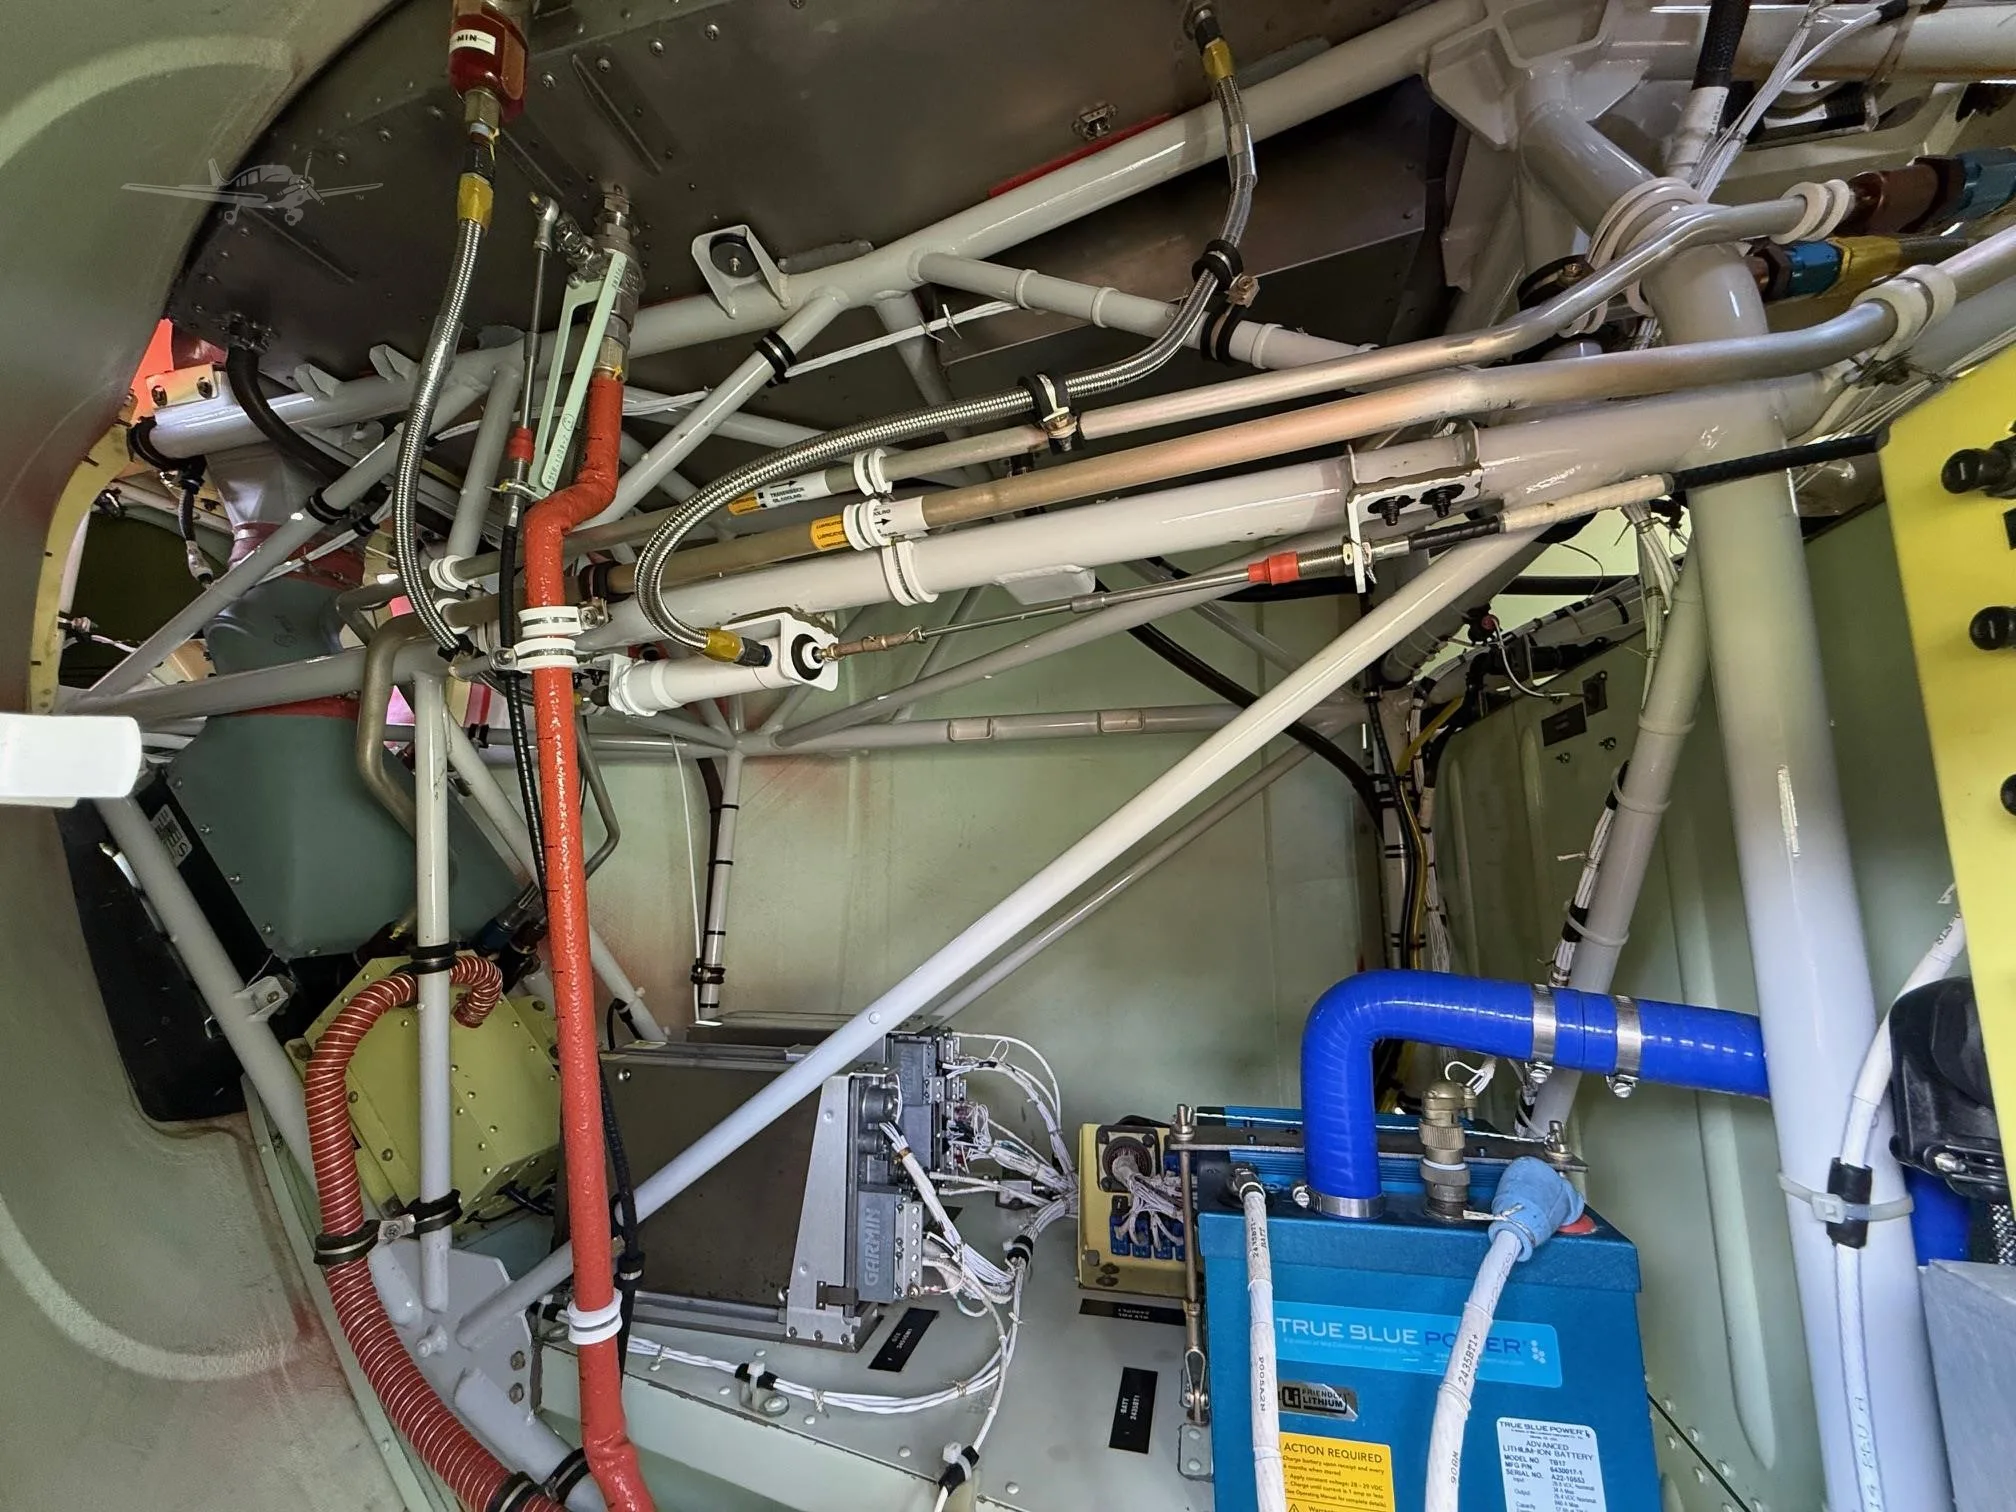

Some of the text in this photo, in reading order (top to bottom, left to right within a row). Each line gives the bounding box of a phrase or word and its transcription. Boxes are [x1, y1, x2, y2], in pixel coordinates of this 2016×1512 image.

[864, 1207, 880, 1286] GARMIN
[1276, 1317, 1343, 1338] TRUE
[1349, 1324, 1420, 1346] BLUE
[1424, 1331, 1522, 1355] POER
[1458, 1334, 1478, 1386] 2435BT1+
[1302, 1396, 1343, 1408] LITHIUM
[1499, 1420, 1523, 1429] TRUE
[1524, 1423, 1548, 1431] BLUE
[1549, 1425, 1583, 1435] POWER
[1526, 1440, 1569, 1450] ADVANCED
[1284, 1442, 1383, 1463] ACTION REQUIRED
[1504, 1454, 1528, 1463] MODEL
[1554, 1450, 1594, 1461] BATTERY
[1505, 1468, 1530, 1477] SERIAL
